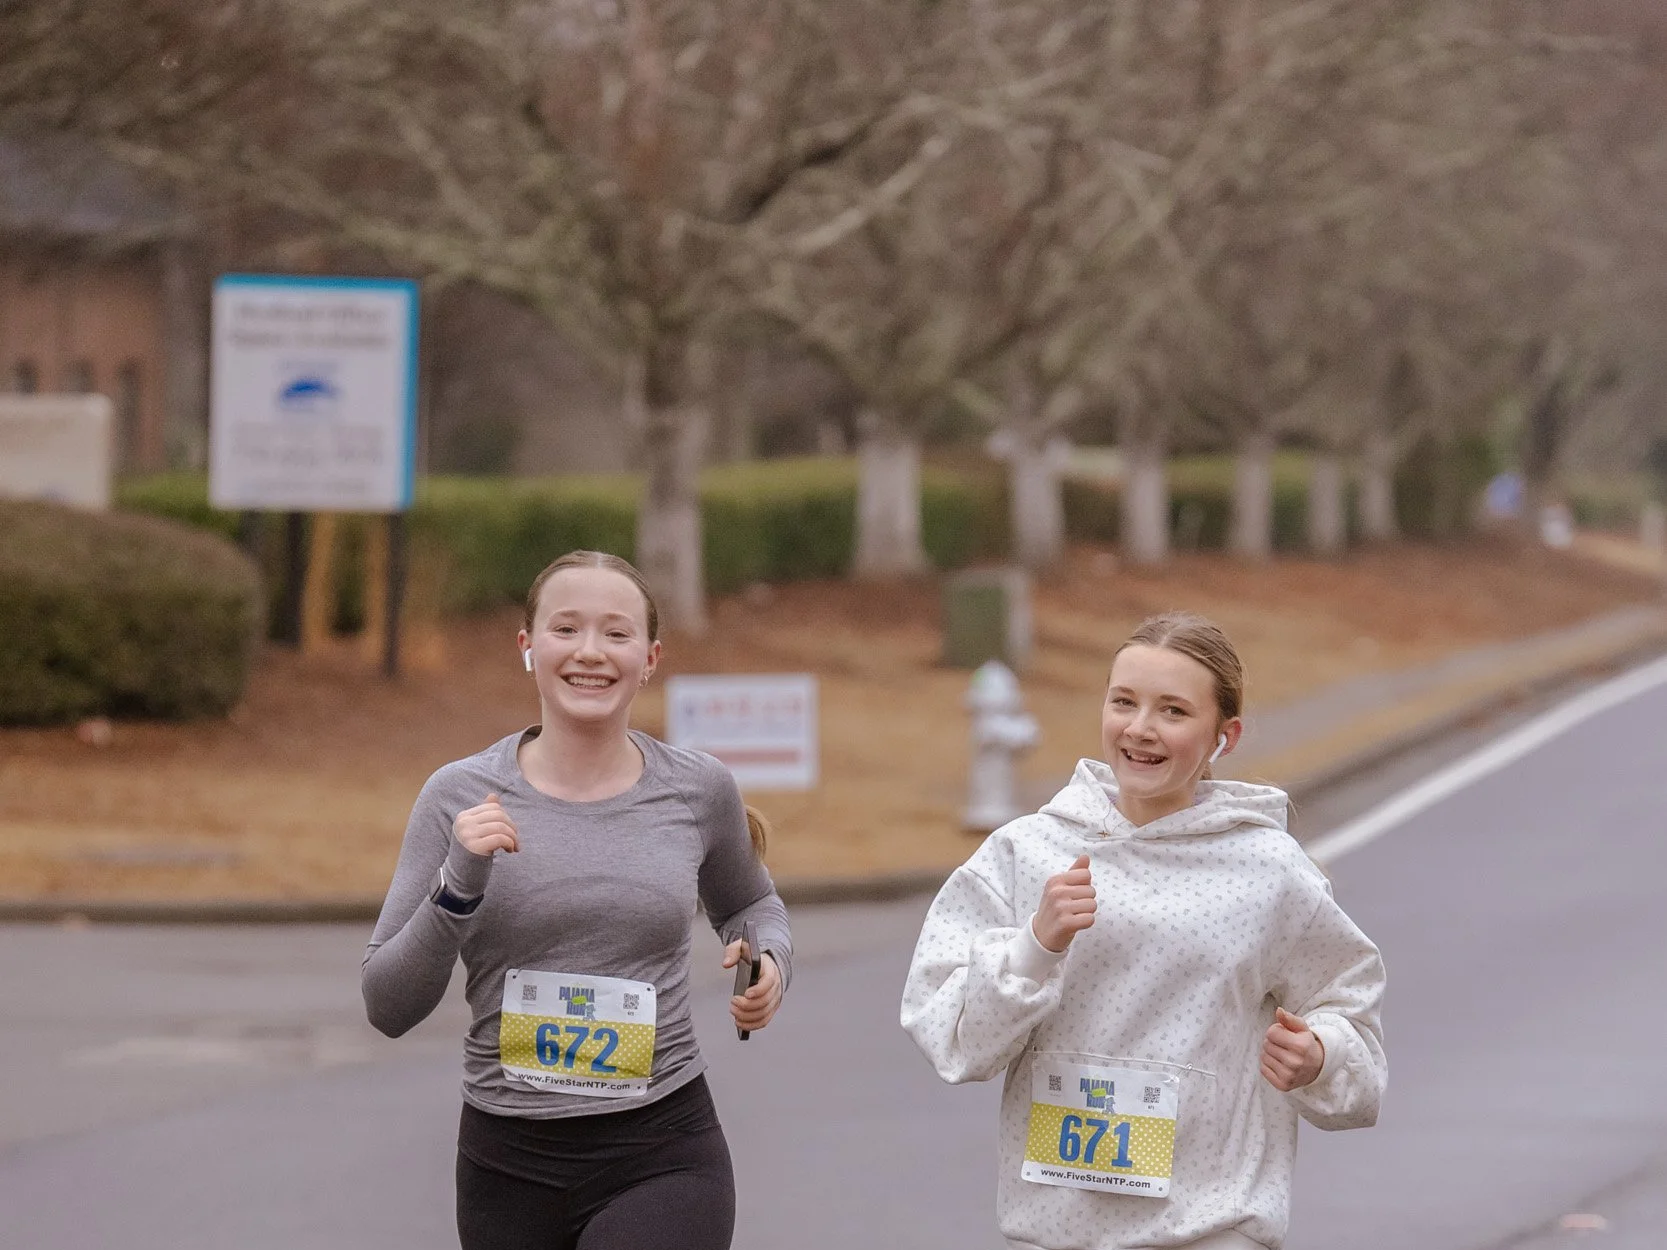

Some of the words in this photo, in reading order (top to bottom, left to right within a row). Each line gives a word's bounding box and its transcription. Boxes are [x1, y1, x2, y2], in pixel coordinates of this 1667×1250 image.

[535, 1023, 619, 1073] 672
[518, 1072, 631, 1091] www.FiveStarNTP.com
[1058, 1114, 1133, 1168] 671
[1040, 1168, 1151, 1189] www.FiveStarNTP.com
